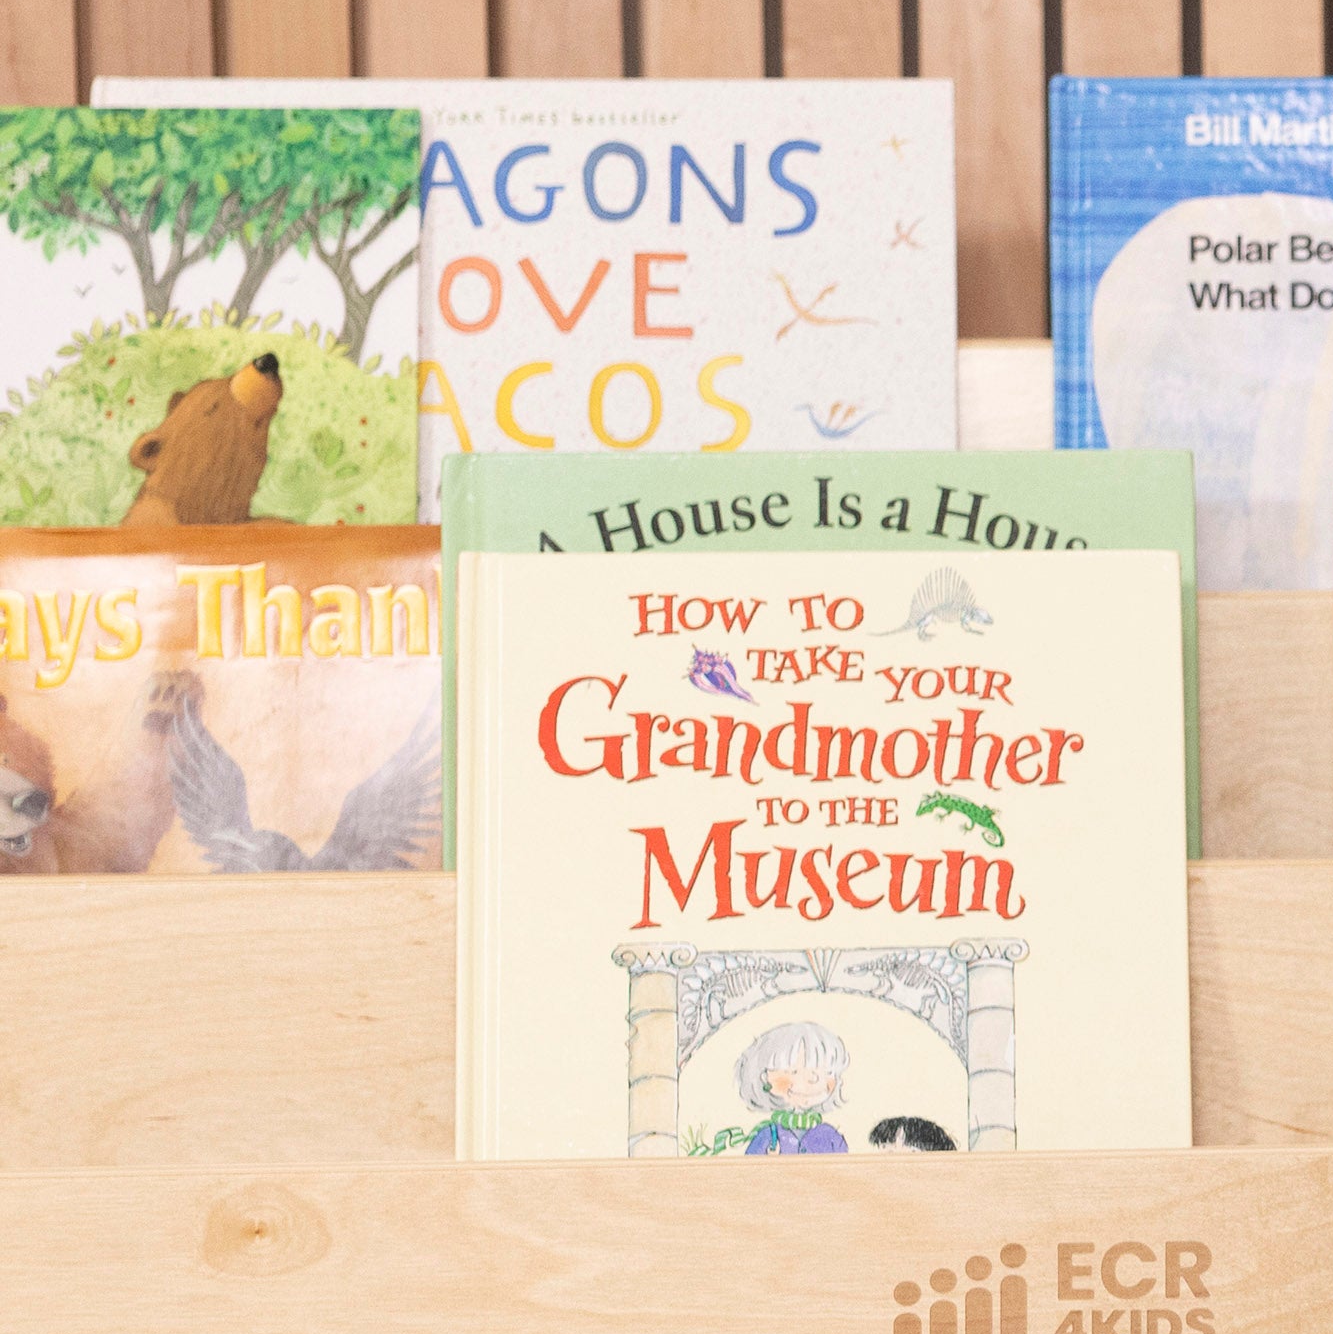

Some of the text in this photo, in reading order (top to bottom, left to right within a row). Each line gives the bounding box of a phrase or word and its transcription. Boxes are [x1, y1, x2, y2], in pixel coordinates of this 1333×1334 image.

[1185, 113, 1241, 147] Bill
[420, 139, 822, 237] AGONS
[1189, 234, 1278, 264] Polar
[438, 251, 695, 338] OVE
[1188, 281, 1279, 310] What
[419, 353, 753, 452] ACOS
[588, 491, 794, 552] House
[812, 476, 864, 530] Is
[878, 496, 911, 533] a
[628, 592, 866, 637] HOW TO
[745, 644, 1014, 707] TAKE YOUR
[536, 673, 1086, 789] Grandmother
[755, 796, 900, 828] TO THE
[628, 817, 1028, 931] Museum
[1055, 1239, 1214, 1302] ECR
